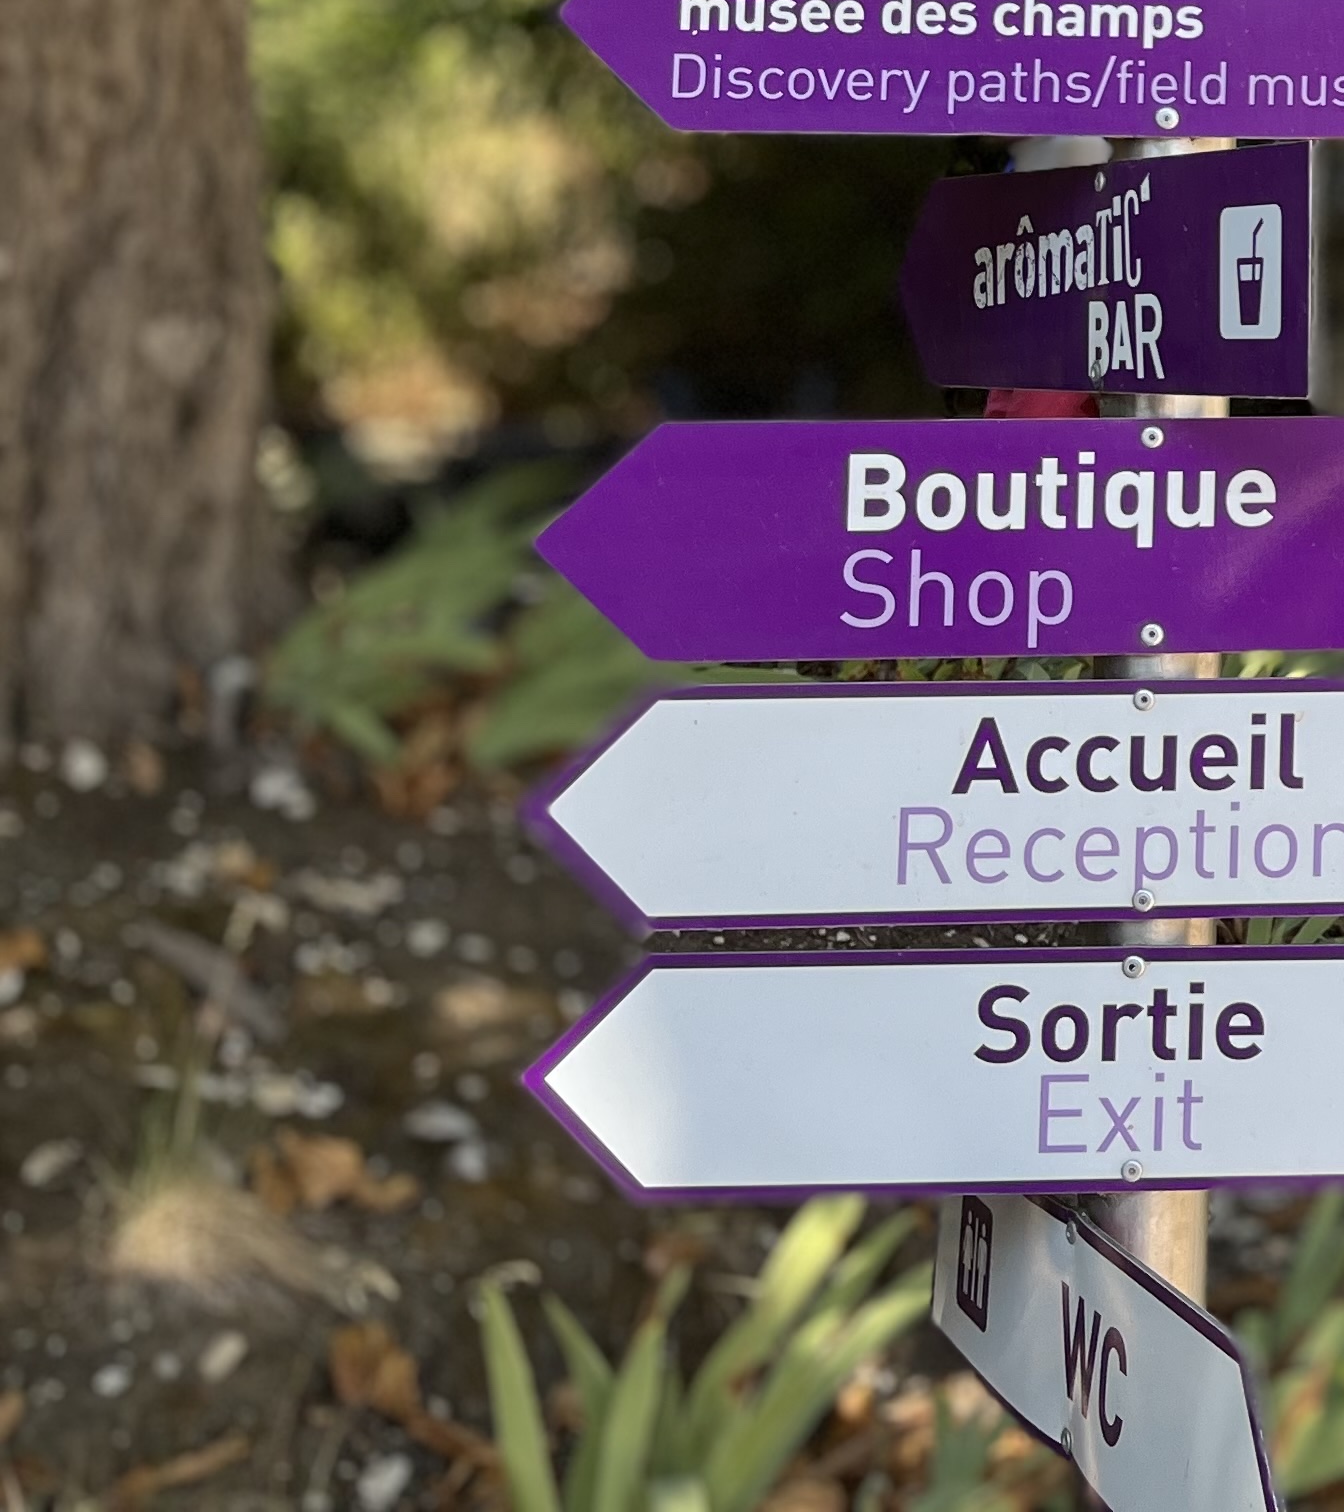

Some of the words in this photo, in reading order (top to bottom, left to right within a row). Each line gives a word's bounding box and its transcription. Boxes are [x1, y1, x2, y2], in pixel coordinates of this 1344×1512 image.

[671, 53, 931, 114] Discovery
[947, 55, 1229, 115] paths/field
[1087, 292, 1165, 379] BAR
[846, 451, 1277, 548] Boutique
[838, 549, 1075, 649] Shop
[951, 713, 1304, 795] Accueil
[973, 981, 1264, 1063] Sortie
[1037, 1073, 1204, 1154] Exit
[1060, 1281, 1127, 1448] WC
